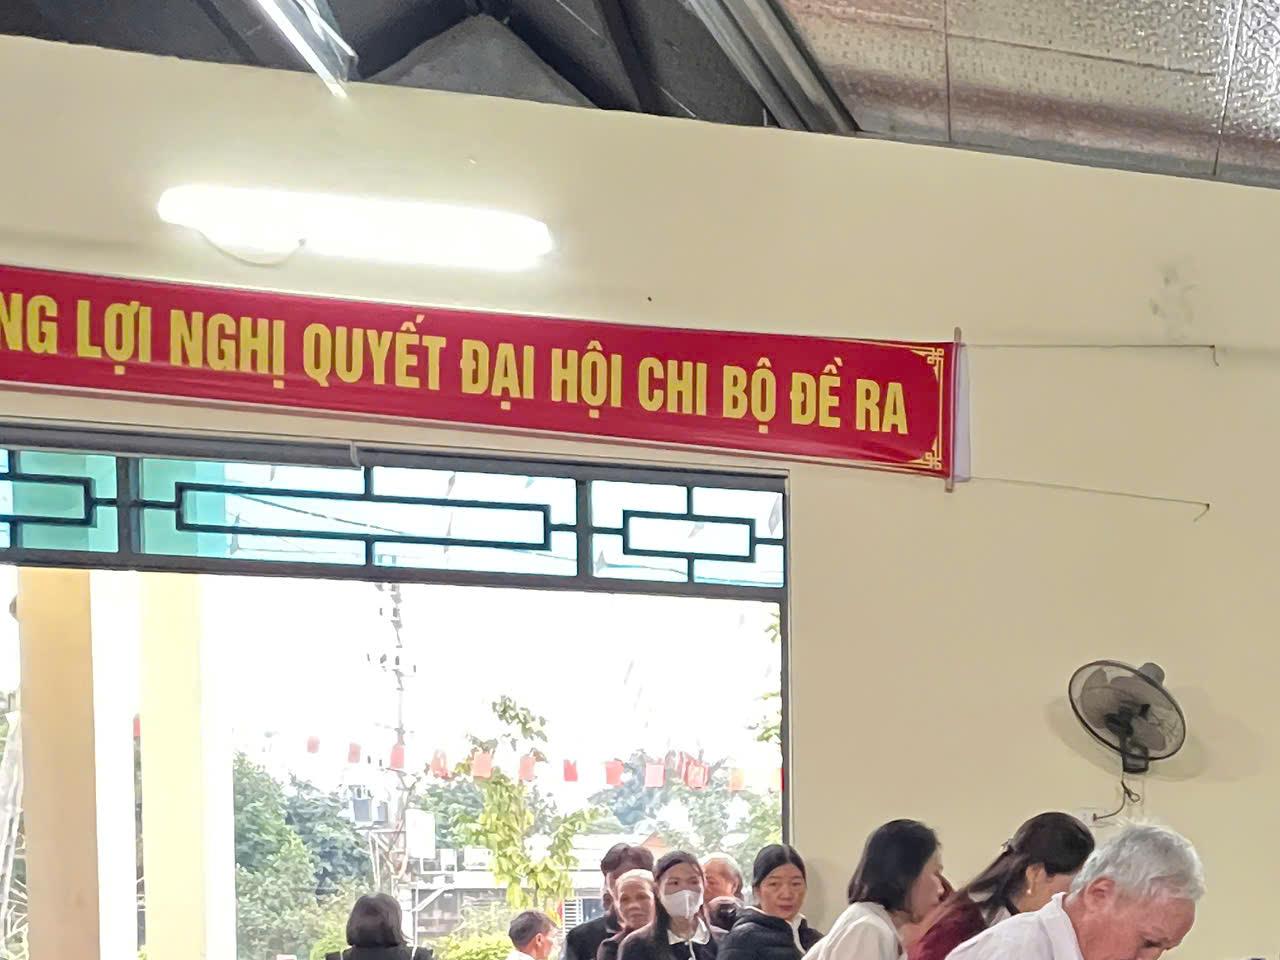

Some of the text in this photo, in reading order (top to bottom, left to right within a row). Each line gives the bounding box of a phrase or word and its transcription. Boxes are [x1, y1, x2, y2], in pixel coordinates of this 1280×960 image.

[0, 291, 908, 434] NG LỢI NGHỊ QUYẾT ĐẠI HỘI CHI BỘ ĐỀ RA
